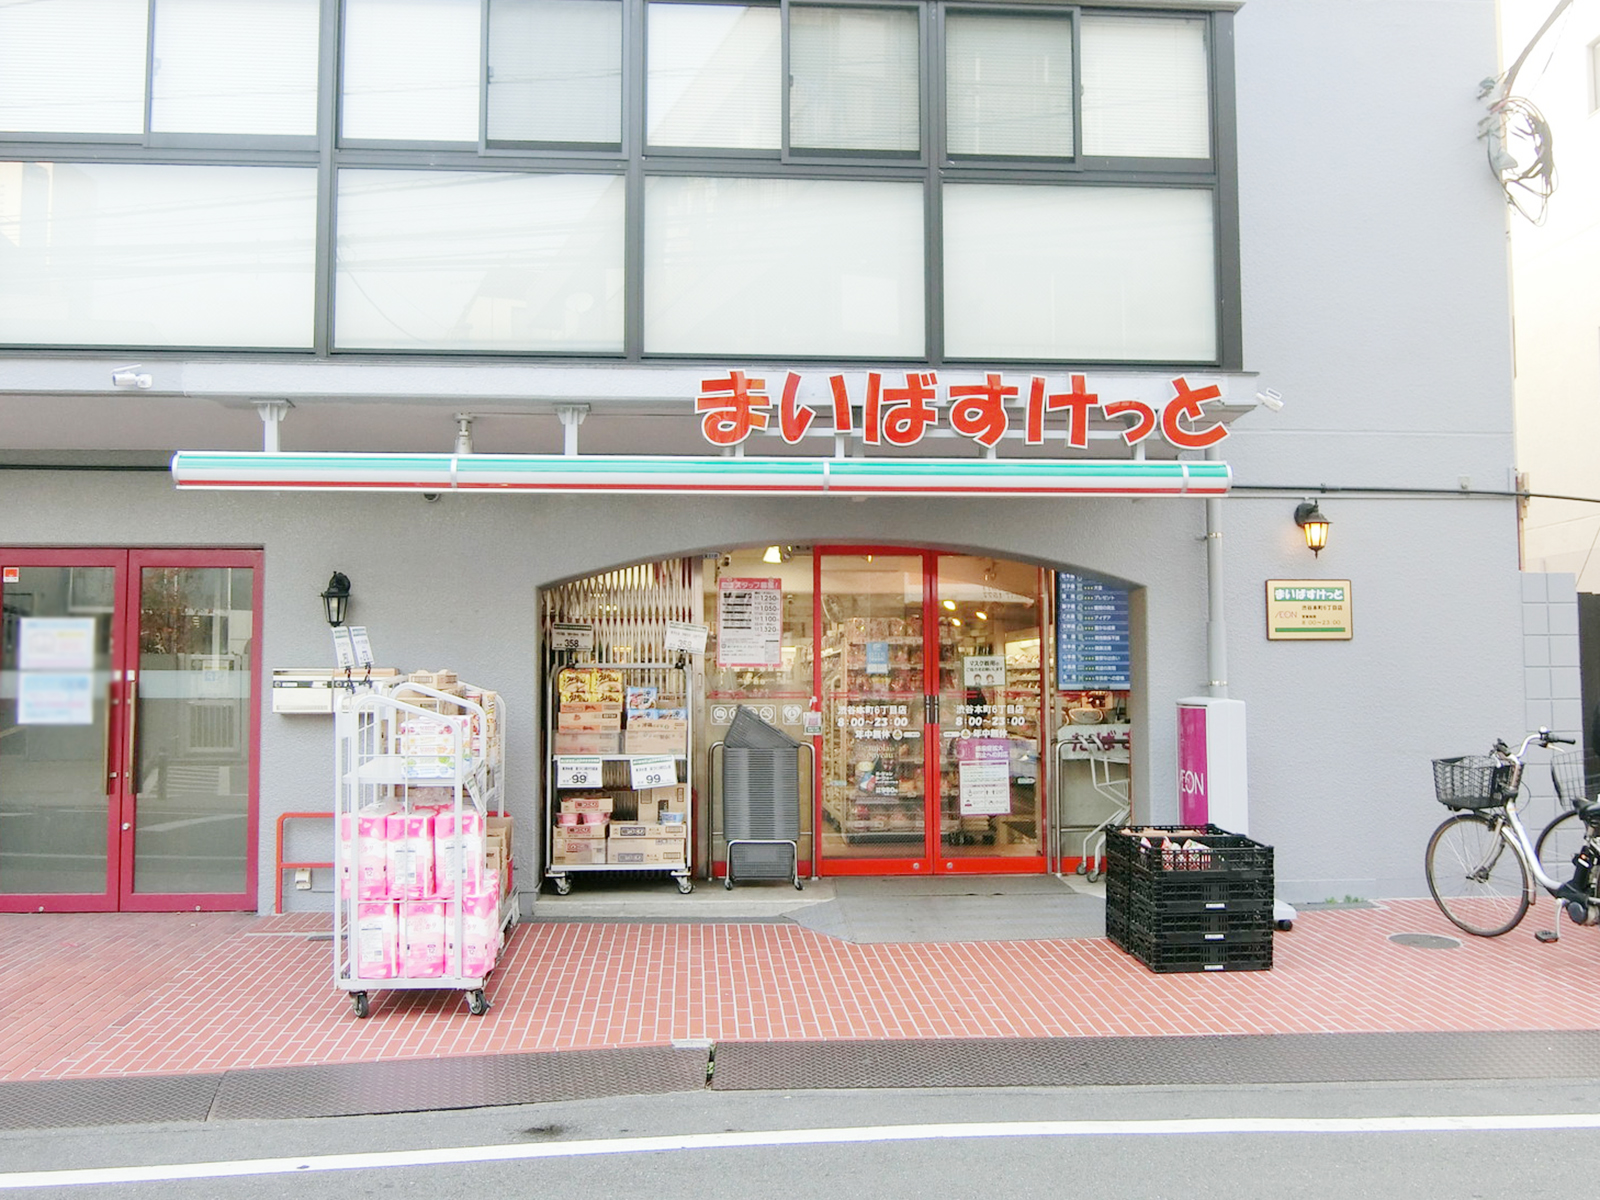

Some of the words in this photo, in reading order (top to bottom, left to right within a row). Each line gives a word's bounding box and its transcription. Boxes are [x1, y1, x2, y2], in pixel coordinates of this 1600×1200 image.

[695, 368, 1230, 450] まいばすけっと
[1275, 588, 1344, 600] まいばすけっと
[564, 639, 579, 648] 358
[838, 705, 907, 715] 渋谷本町6丁目店
[956, 704, 1024, 714] 渋谷本町6丁目店
[855, 730, 891, 739] 年中無休
[973, 729, 1008, 738] 年中無休
[572, 774, 587, 784] 99
[646, 774, 661, 784] 99
